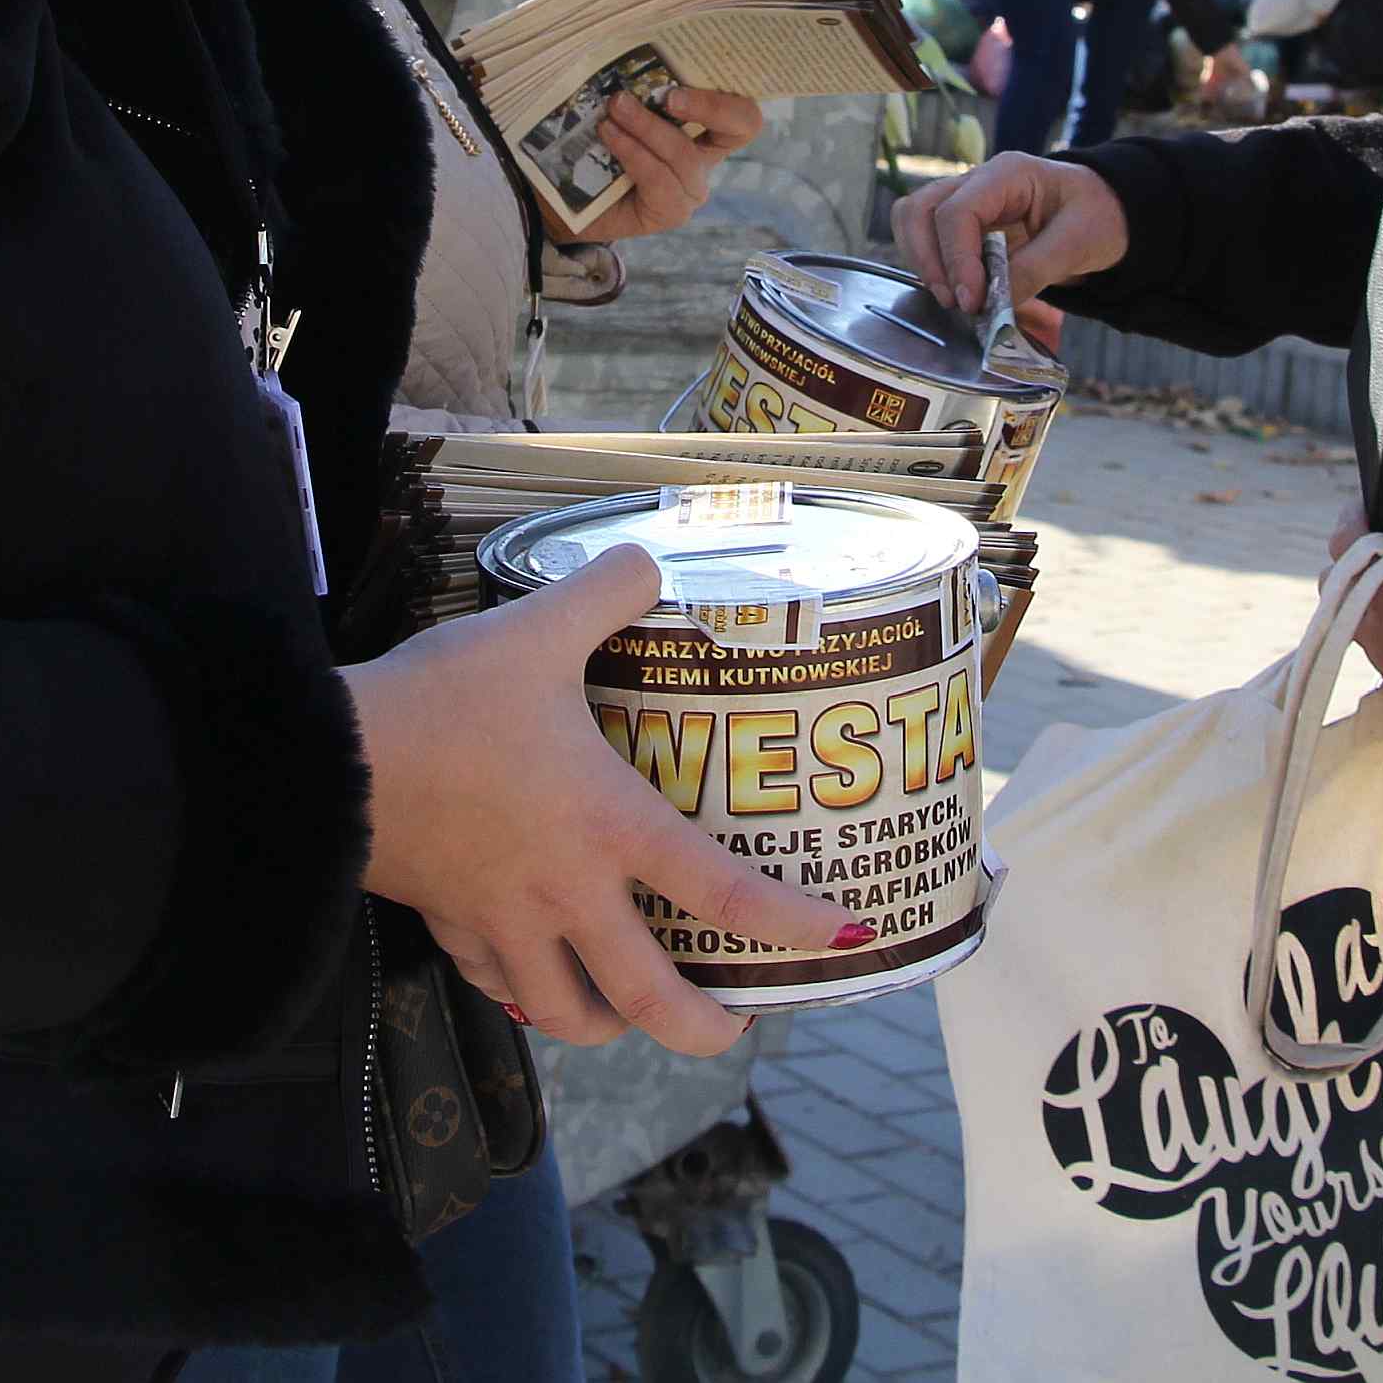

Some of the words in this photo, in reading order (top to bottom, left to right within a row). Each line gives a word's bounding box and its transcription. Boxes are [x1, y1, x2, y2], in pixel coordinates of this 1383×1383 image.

[642, 666, 710, 686] ZIEMI
[720, 652, 893, 687] KUTNOWSKIEJ
[837, 794, 964, 849] STARYCH,
[801, 817, 971, 886] NAGROBKÓW
[1115, 1002, 1179, 1065] To
